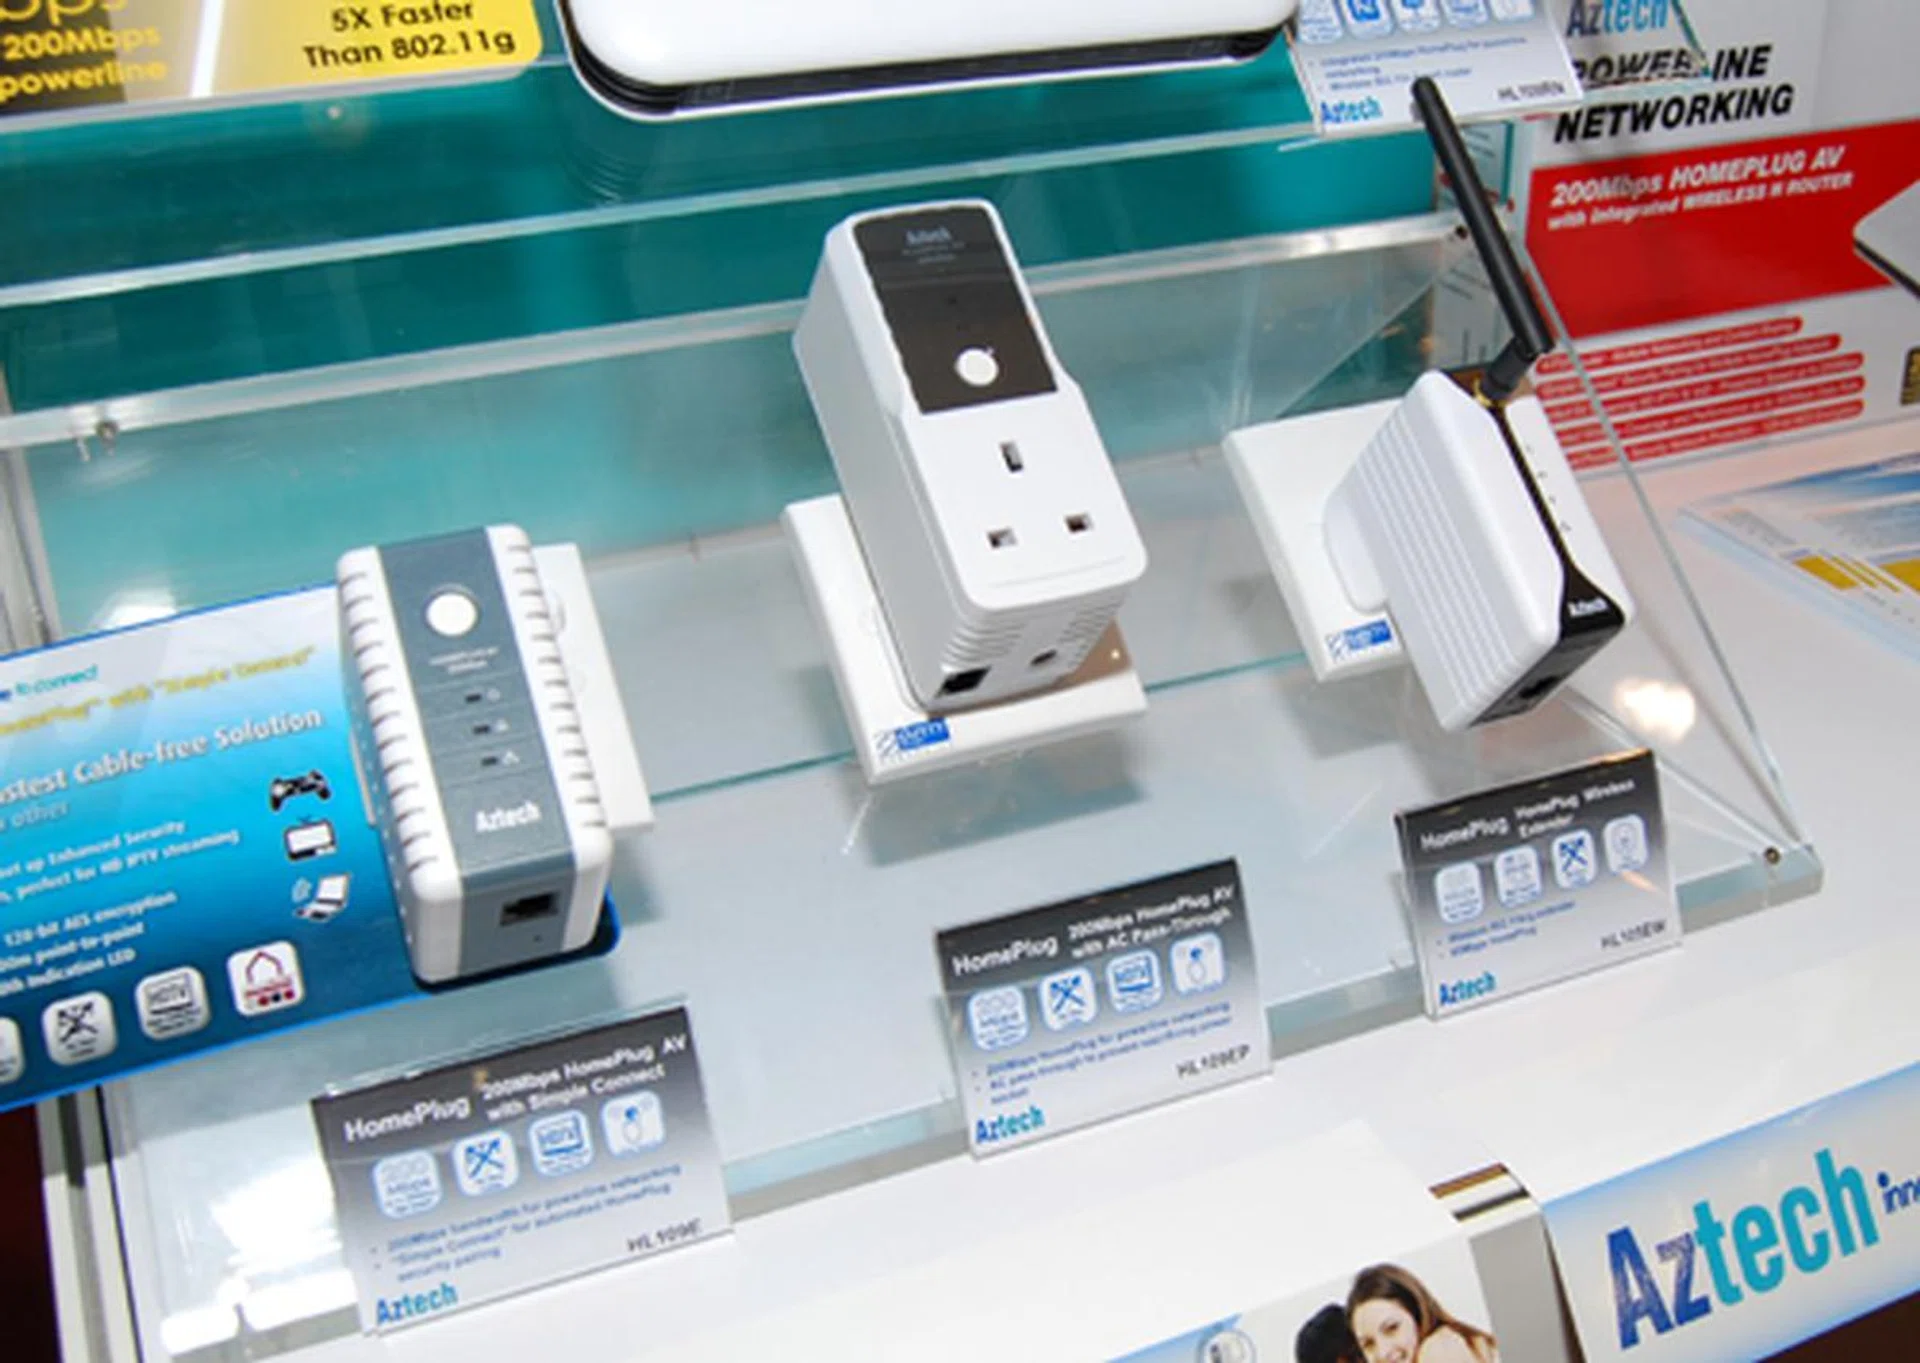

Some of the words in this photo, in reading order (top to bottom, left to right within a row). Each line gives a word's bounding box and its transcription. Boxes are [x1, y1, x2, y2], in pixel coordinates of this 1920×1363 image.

[332, 7, 371, 32] 5X
[381, 0, 473, 27] Faster
[1566, 0, 1668, 36] Aztech
[3, 25, 161, 61] 200Mbps
[304, 45, 383, 68] Than
[391, 30, 516, 60] 802.11g
[0, 60, 167, 104] powerline
[1555, 84, 1794, 144] NETWORKING
[1551, 174, 1663, 206] 200Mbps
[1669, 150, 1806, 189] HOMEPLUG
[1811, 145, 1845, 170] AV
[1547, 211, 1586, 231] with
[73, 735, 207, 784] Cable-free
[214, 709, 322, 749] Solution
[476, 800, 542, 832] Aztech
[1421, 816, 1508, 850] HomePlug
[954, 935, 1058, 975] HomePlug
[1069, 913, 1133, 938] 200Mbps
[1137, 894, 1209, 921] HomePlug
[1071, 940, 1102, 957] with
[1105, 933, 1128, 948] AC
[1439, 972, 1495, 1003] Aztech
[345, 1096, 470, 1144] HomePlug
[565, 1045, 653, 1080] HomePlug
[661, 1035, 687, 1051] AV
[486, 1100, 524, 1119] with
[529, 1084, 588, 1110] Simple
[592, 1065, 664, 1093] Connect
[975, 1105, 1043, 1142] Aztech
[1606, 1147, 1880, 1350] Aztech
[375, 1282, 457, 1324] Aztech
